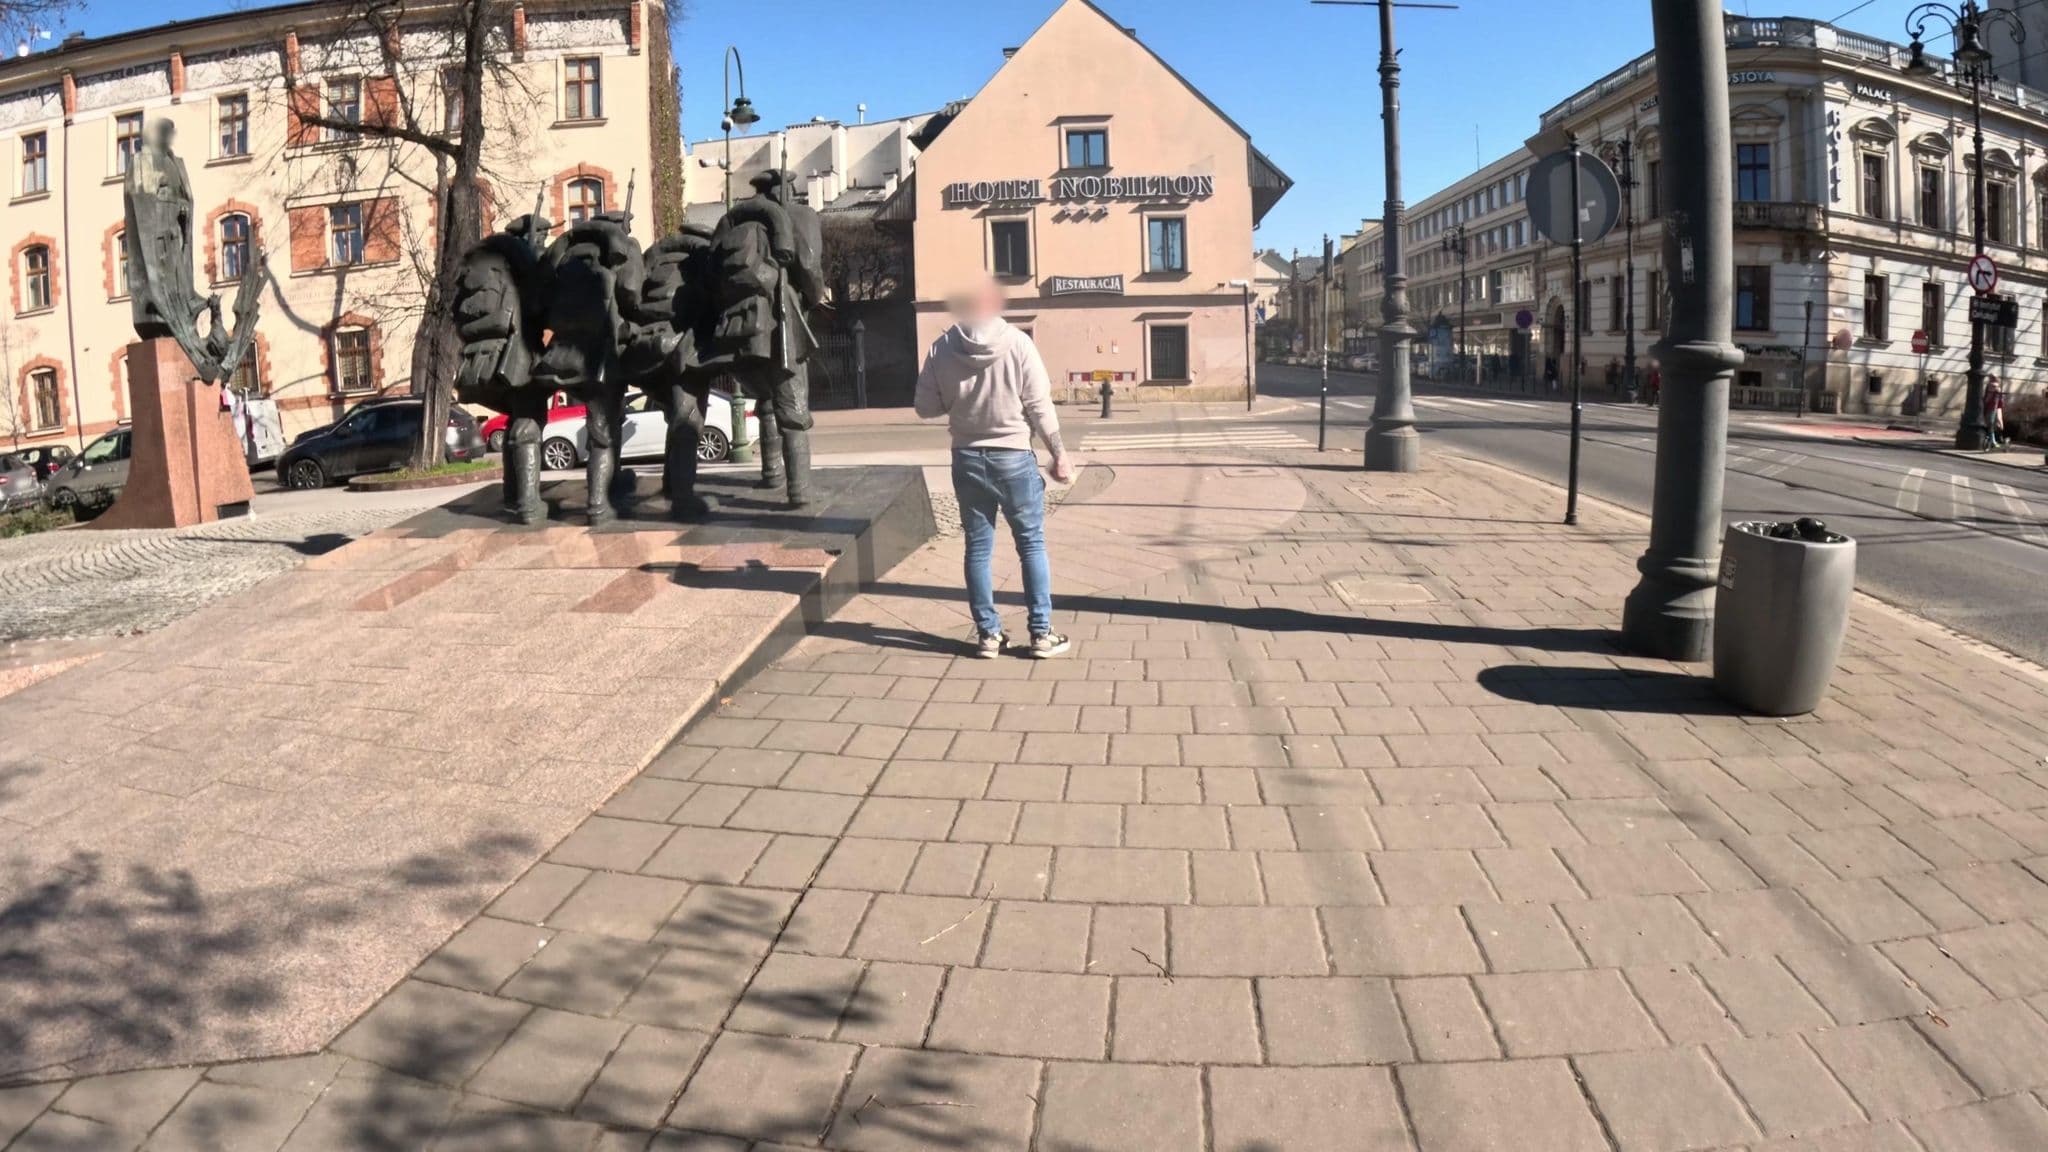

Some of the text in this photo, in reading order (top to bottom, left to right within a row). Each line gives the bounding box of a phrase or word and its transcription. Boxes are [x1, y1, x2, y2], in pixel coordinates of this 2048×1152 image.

[1856, 83, 1892, 101] PALACE
[949, 175, 1214, 203] HOTEL NOBILTON
[1055, 277, 1121, 292] RESTAURACJA
